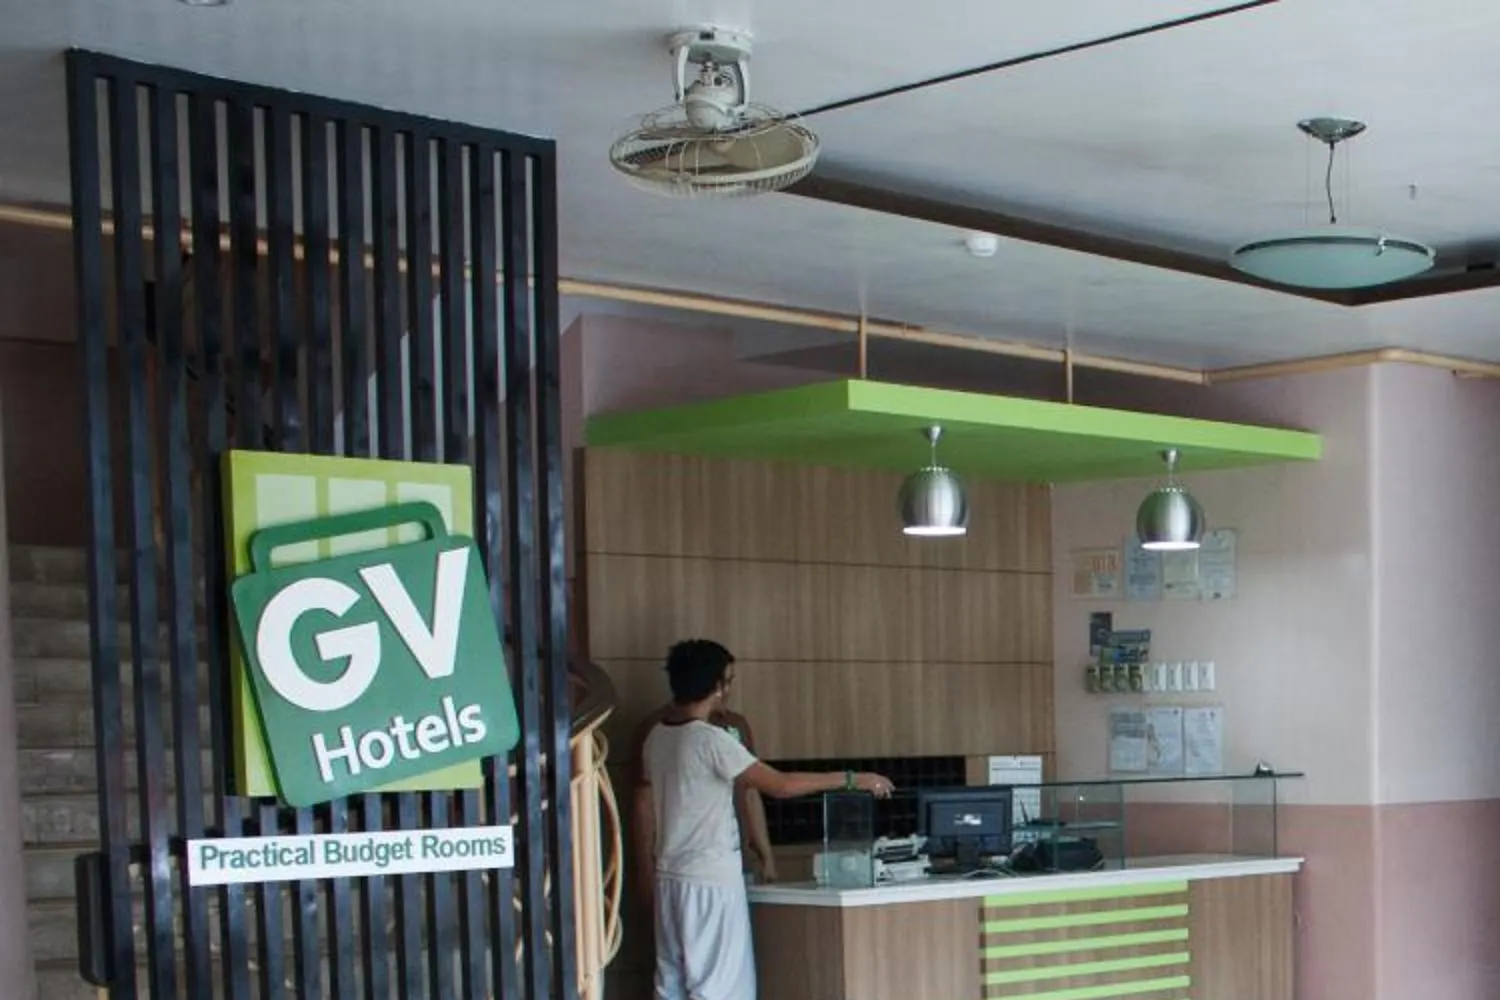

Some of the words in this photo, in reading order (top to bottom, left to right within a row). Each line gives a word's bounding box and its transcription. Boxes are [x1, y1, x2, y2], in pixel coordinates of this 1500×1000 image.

[256, 546, 470, 711] GV
[312, 696, 487, 783] Hotels
[200, 839, 315, 870] Practical
[323, 836, 413, 868] Budget
[420, 834, 506, 860] Rooms
